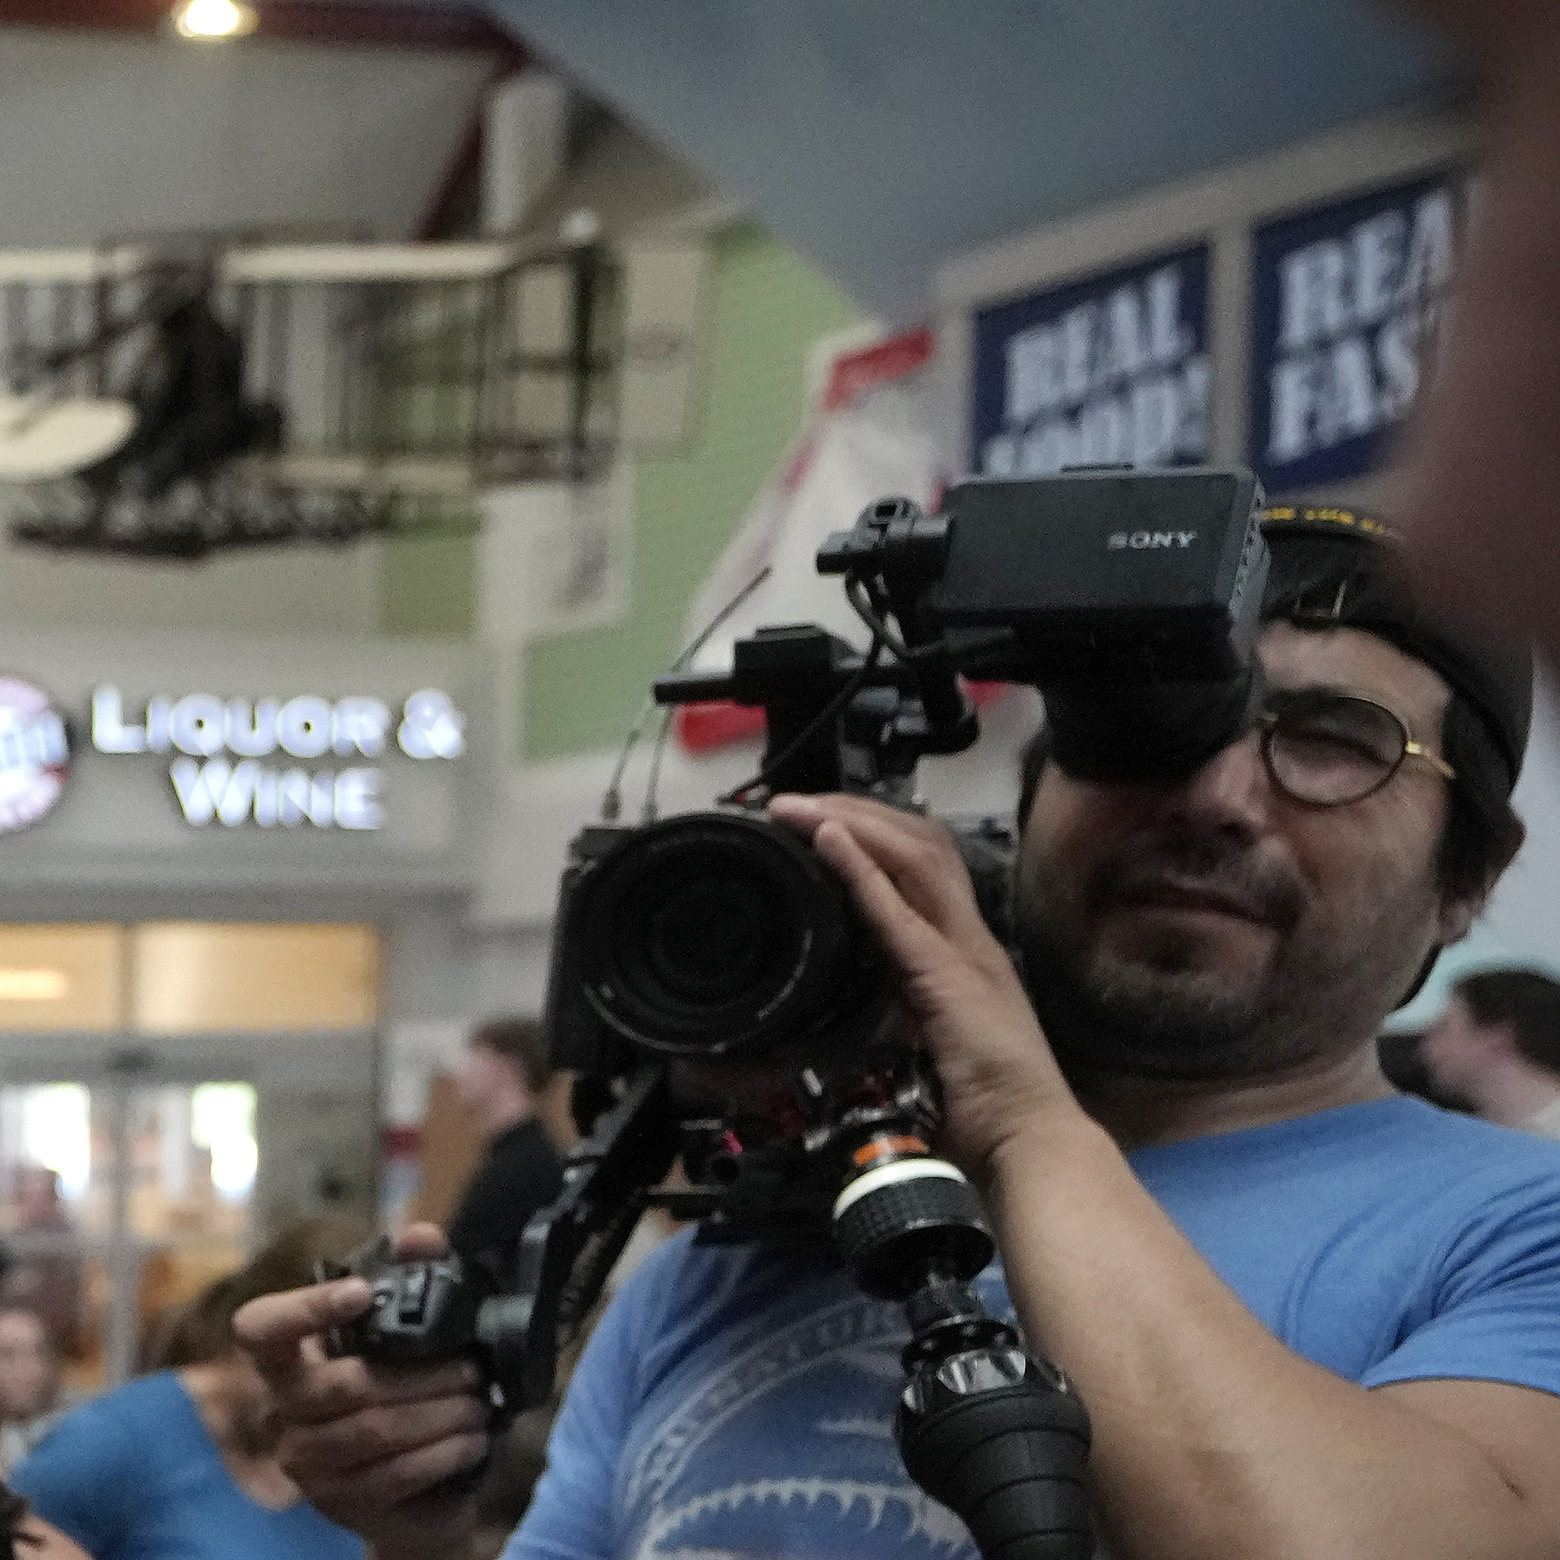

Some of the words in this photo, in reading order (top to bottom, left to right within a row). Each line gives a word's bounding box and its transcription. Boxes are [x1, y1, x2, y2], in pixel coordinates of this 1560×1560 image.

[1007, 268, 1193, 420] REAL
[1107, 530, 1198, 550] SONY
[92, 685, 392, 758] LIQUOR
[397, 687, 465, 759] &
[169, 758, 385, 829] WINE
